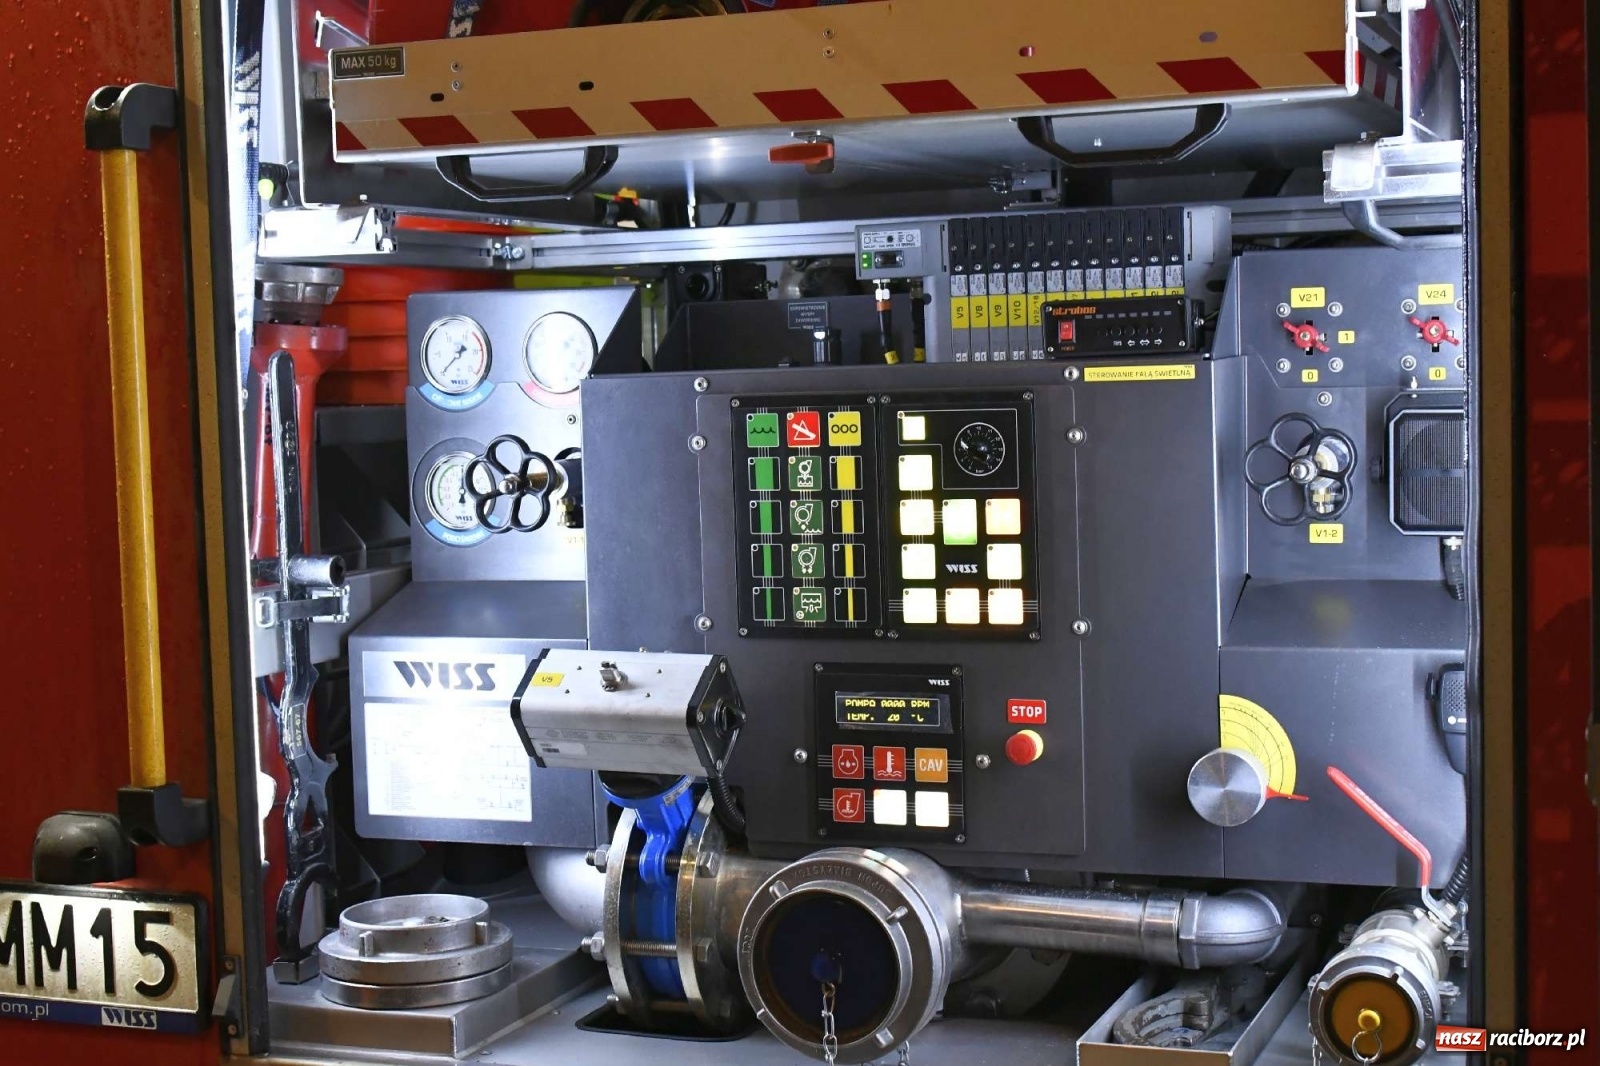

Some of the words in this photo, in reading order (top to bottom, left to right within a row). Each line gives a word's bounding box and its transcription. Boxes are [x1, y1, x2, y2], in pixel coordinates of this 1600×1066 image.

[341, 56, 366, 70] MAX
[367, 55, 382, 67] 50
[384, 54, 396, 69] kg
[1298, 292, 1319, 302] V21
[1425, 288, 1447, 299] V24
[956, 306, 964, 319] V5
[975, 305, 983, 318] V8
[994, 304, 1002, 317] V9
[1013, 300, 1022, 320] V10
[1344, 332, 1349, 341] 1
[1088, 369, 1134, 379] STEROWANIE
[1307, 371, 1314, 380] 0
[1434, 368, 1441, 379] 0
[1315, 529, 1338, 538] V1-2
[945, 563, 979, 574] WISS
[392, 660, 497, 692] WISS
[928, 678, 951, 687] WISS
[1011, 705, 1043, 718] STOP
[919, 758, 943, 772] CAV
[103, 1008, 156, 1027] WISS
